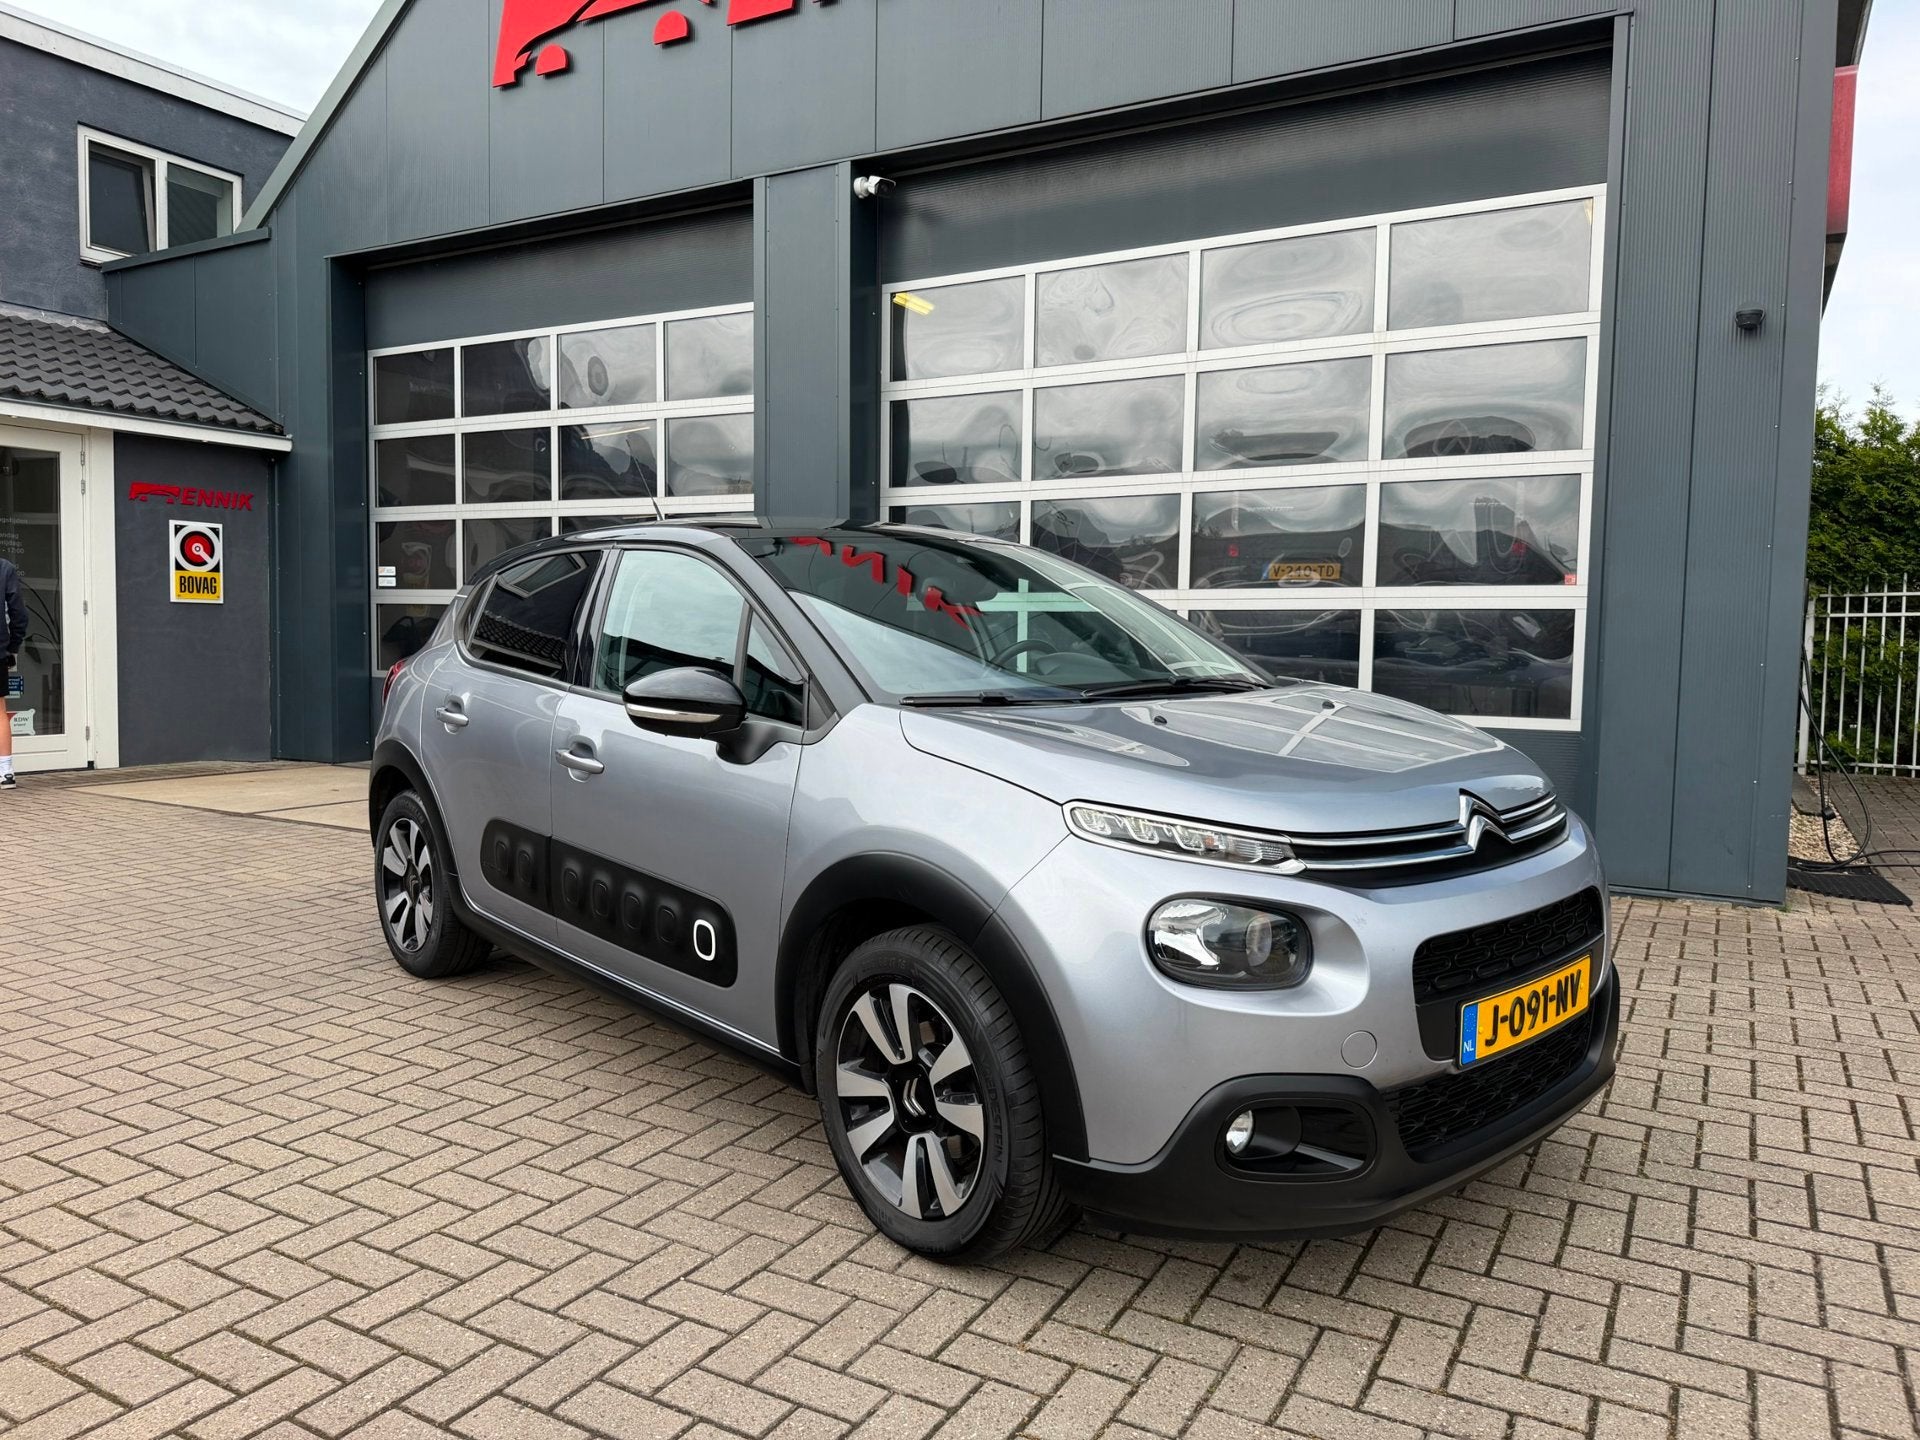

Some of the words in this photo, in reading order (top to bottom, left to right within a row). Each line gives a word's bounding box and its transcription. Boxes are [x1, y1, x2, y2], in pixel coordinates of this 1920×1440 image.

[179, 575, 217, 594] BOVAG
[1485, 969, 1582, 1048] J-091-NV
[1463, 1040, 1475, 1053] NL
